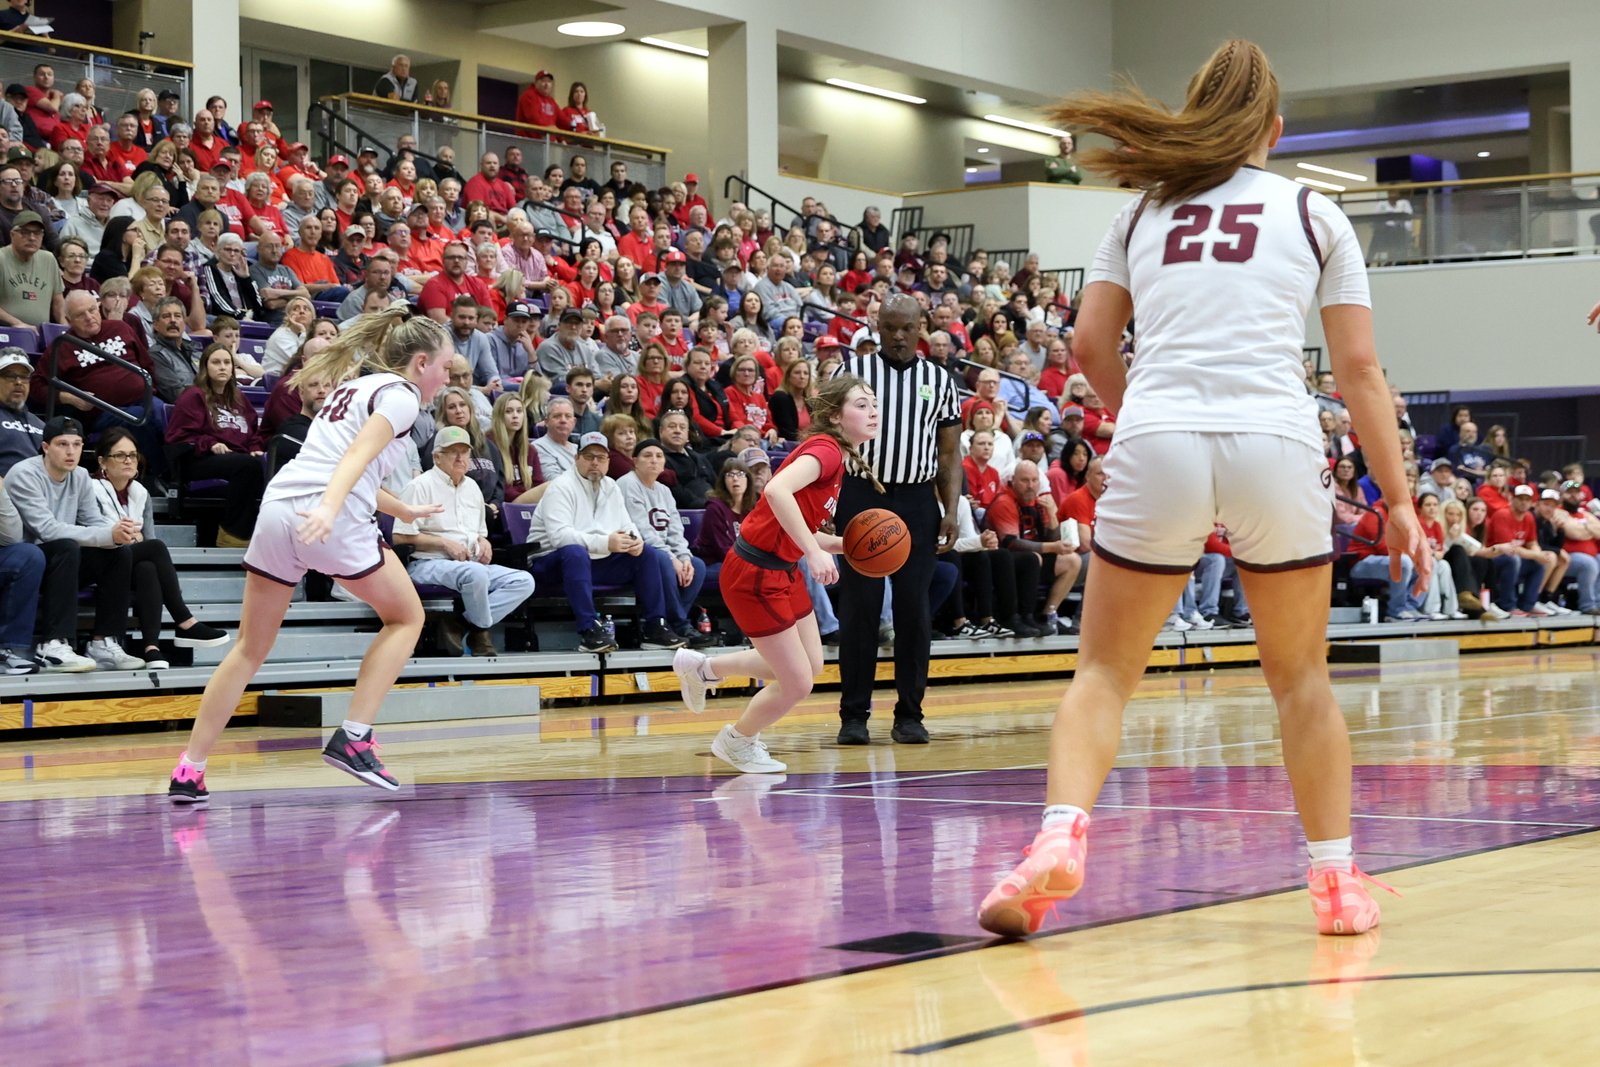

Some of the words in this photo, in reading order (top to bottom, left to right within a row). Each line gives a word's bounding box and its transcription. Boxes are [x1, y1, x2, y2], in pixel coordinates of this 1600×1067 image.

[1162, 203, 1265, 265] 25
[9, 273, 46, 290] HURLEY
[1320, 468, 1332, 490] G
[648, 508, 670, 531] G
[867, 522, 902, 552] Rawlings
